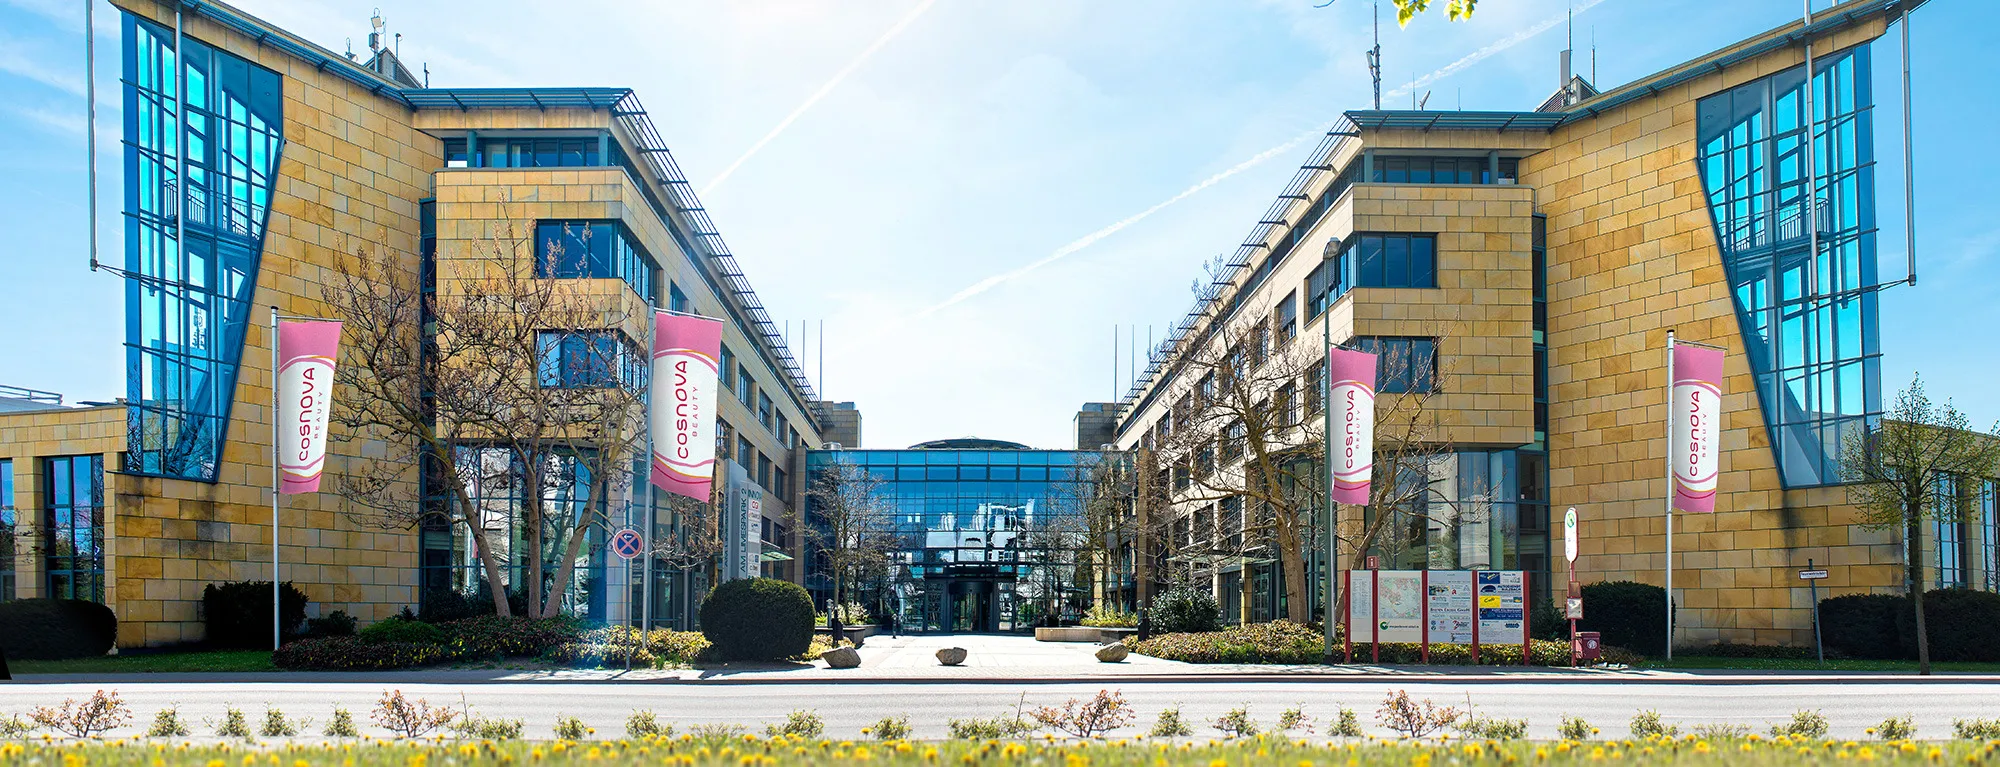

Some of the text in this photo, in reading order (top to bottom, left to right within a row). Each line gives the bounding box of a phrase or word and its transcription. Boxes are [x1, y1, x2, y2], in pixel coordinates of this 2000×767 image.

[313, 391, 323, 439] BEAUTY
[692, 386, 700, 437] BEAUTY
[740, 498, 748, 554] LIMESPARK
[739, 558, 746, 573] AM
